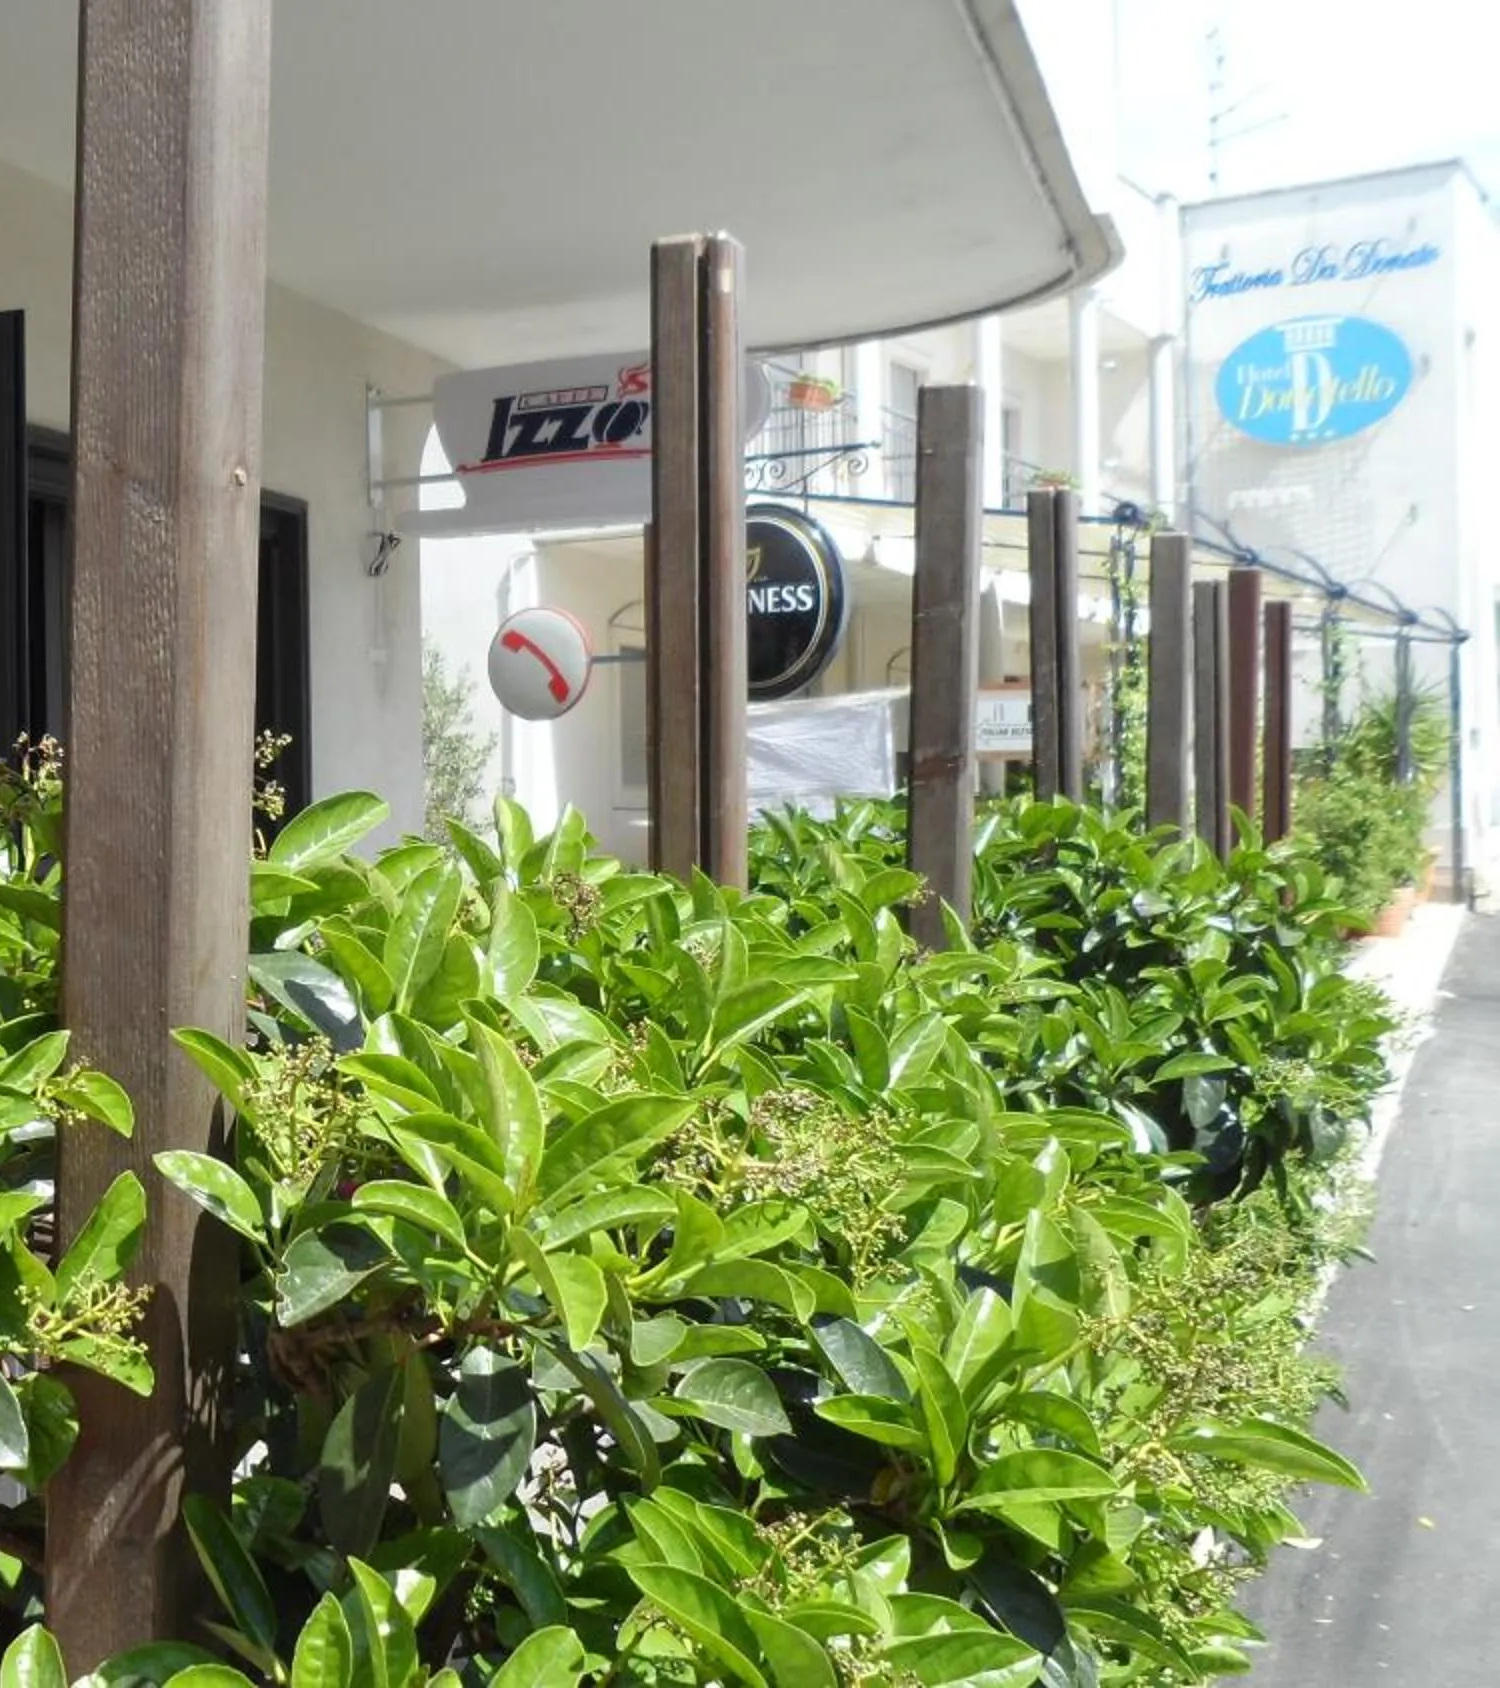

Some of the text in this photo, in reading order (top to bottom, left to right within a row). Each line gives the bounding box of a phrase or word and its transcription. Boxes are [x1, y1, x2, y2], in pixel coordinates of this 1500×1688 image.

[1190, 238, 1440, 304] Trattoria Da Donato
[747, 584, 814, 614] NESS
